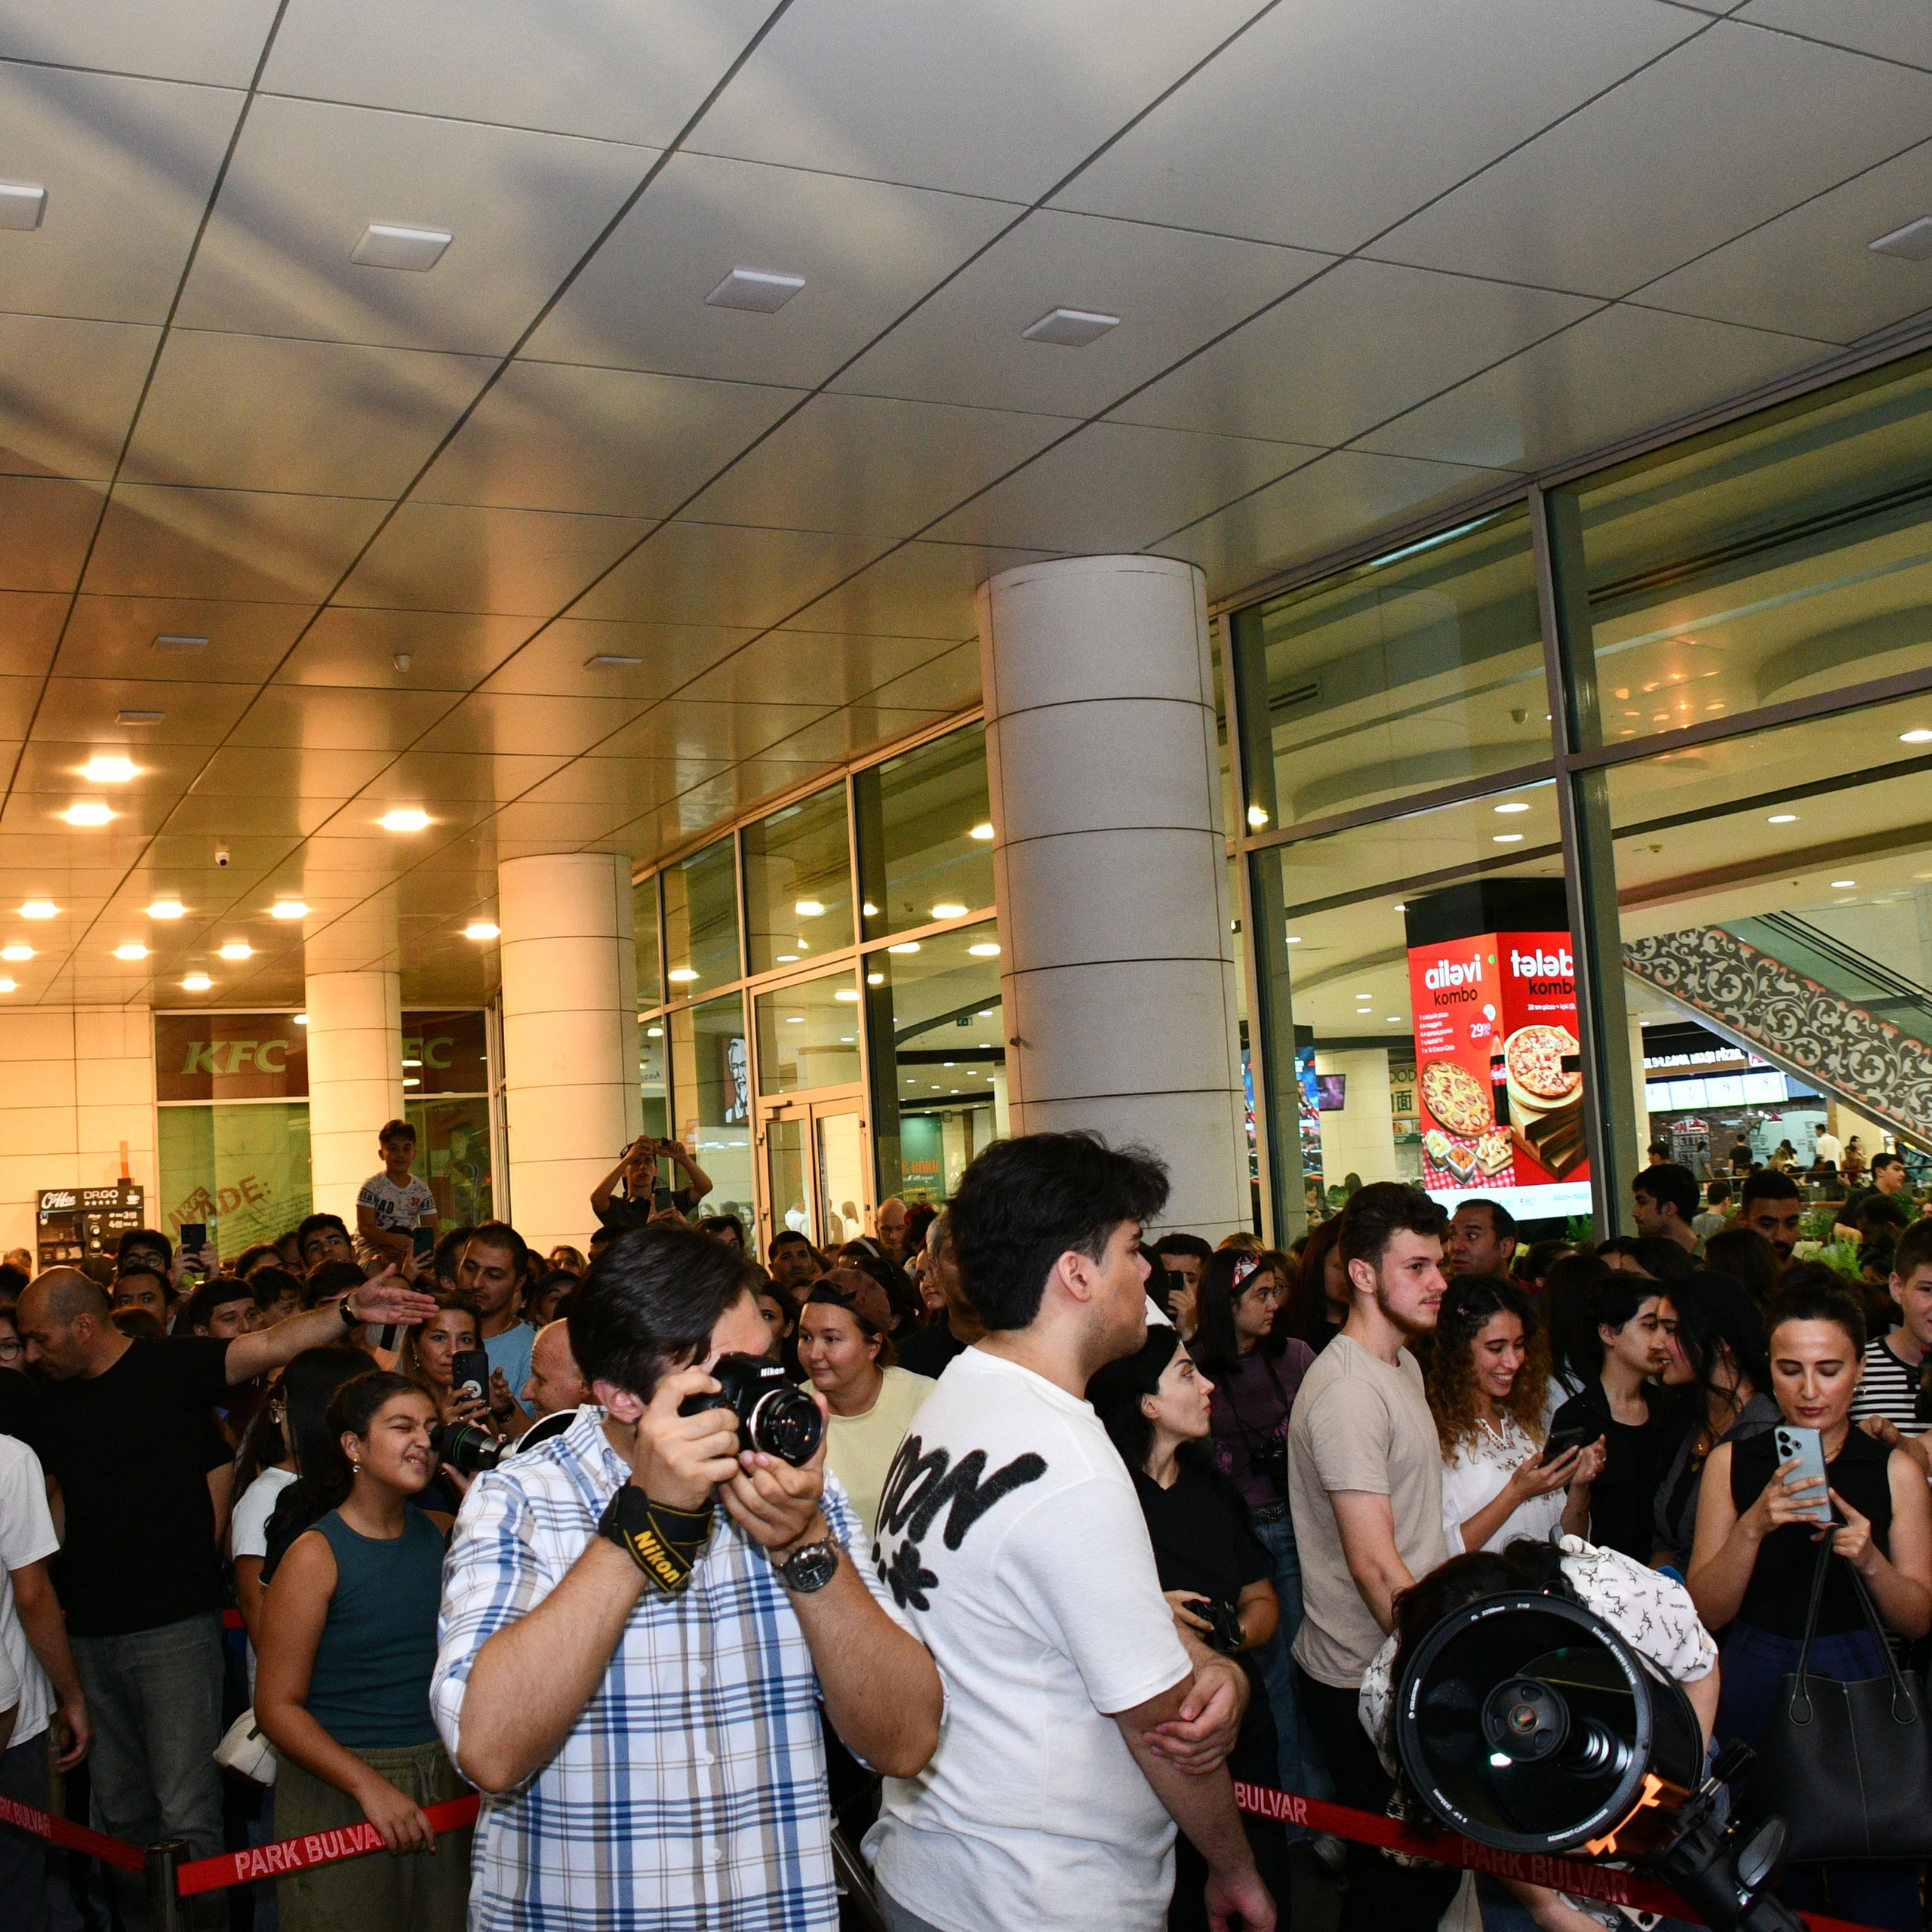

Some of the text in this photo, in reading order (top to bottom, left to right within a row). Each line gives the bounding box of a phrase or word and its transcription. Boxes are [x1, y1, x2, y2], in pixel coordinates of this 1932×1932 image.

[1425, 953, 1482, 989] ailəvi
[1510, 949, 1574, 977] tələb
[1433, 986, 1478, 1006] kombo
[1528, 978, 1576, 995] komb
[180, 1040, 290, 1075] KFC
[402, 1037, 454, 1070] FC
[1389, 1069, 1417, 1084] OOD
[1391, 1089, 1412, 1113] 面
[42, 1192, 76, 1209] Coffee
[760, 1367, 786, 1377] Nikon
[634, 1530, 681, 1583] Nikon
[13, 1801, 52, 1838] BULVAR
[1234, 1781, 1309, 1825] BULVAR
[235, 1823, 386, 1880] PARK BULVA
[1462, 1837, 1629, 1905] PARK BULVAR
